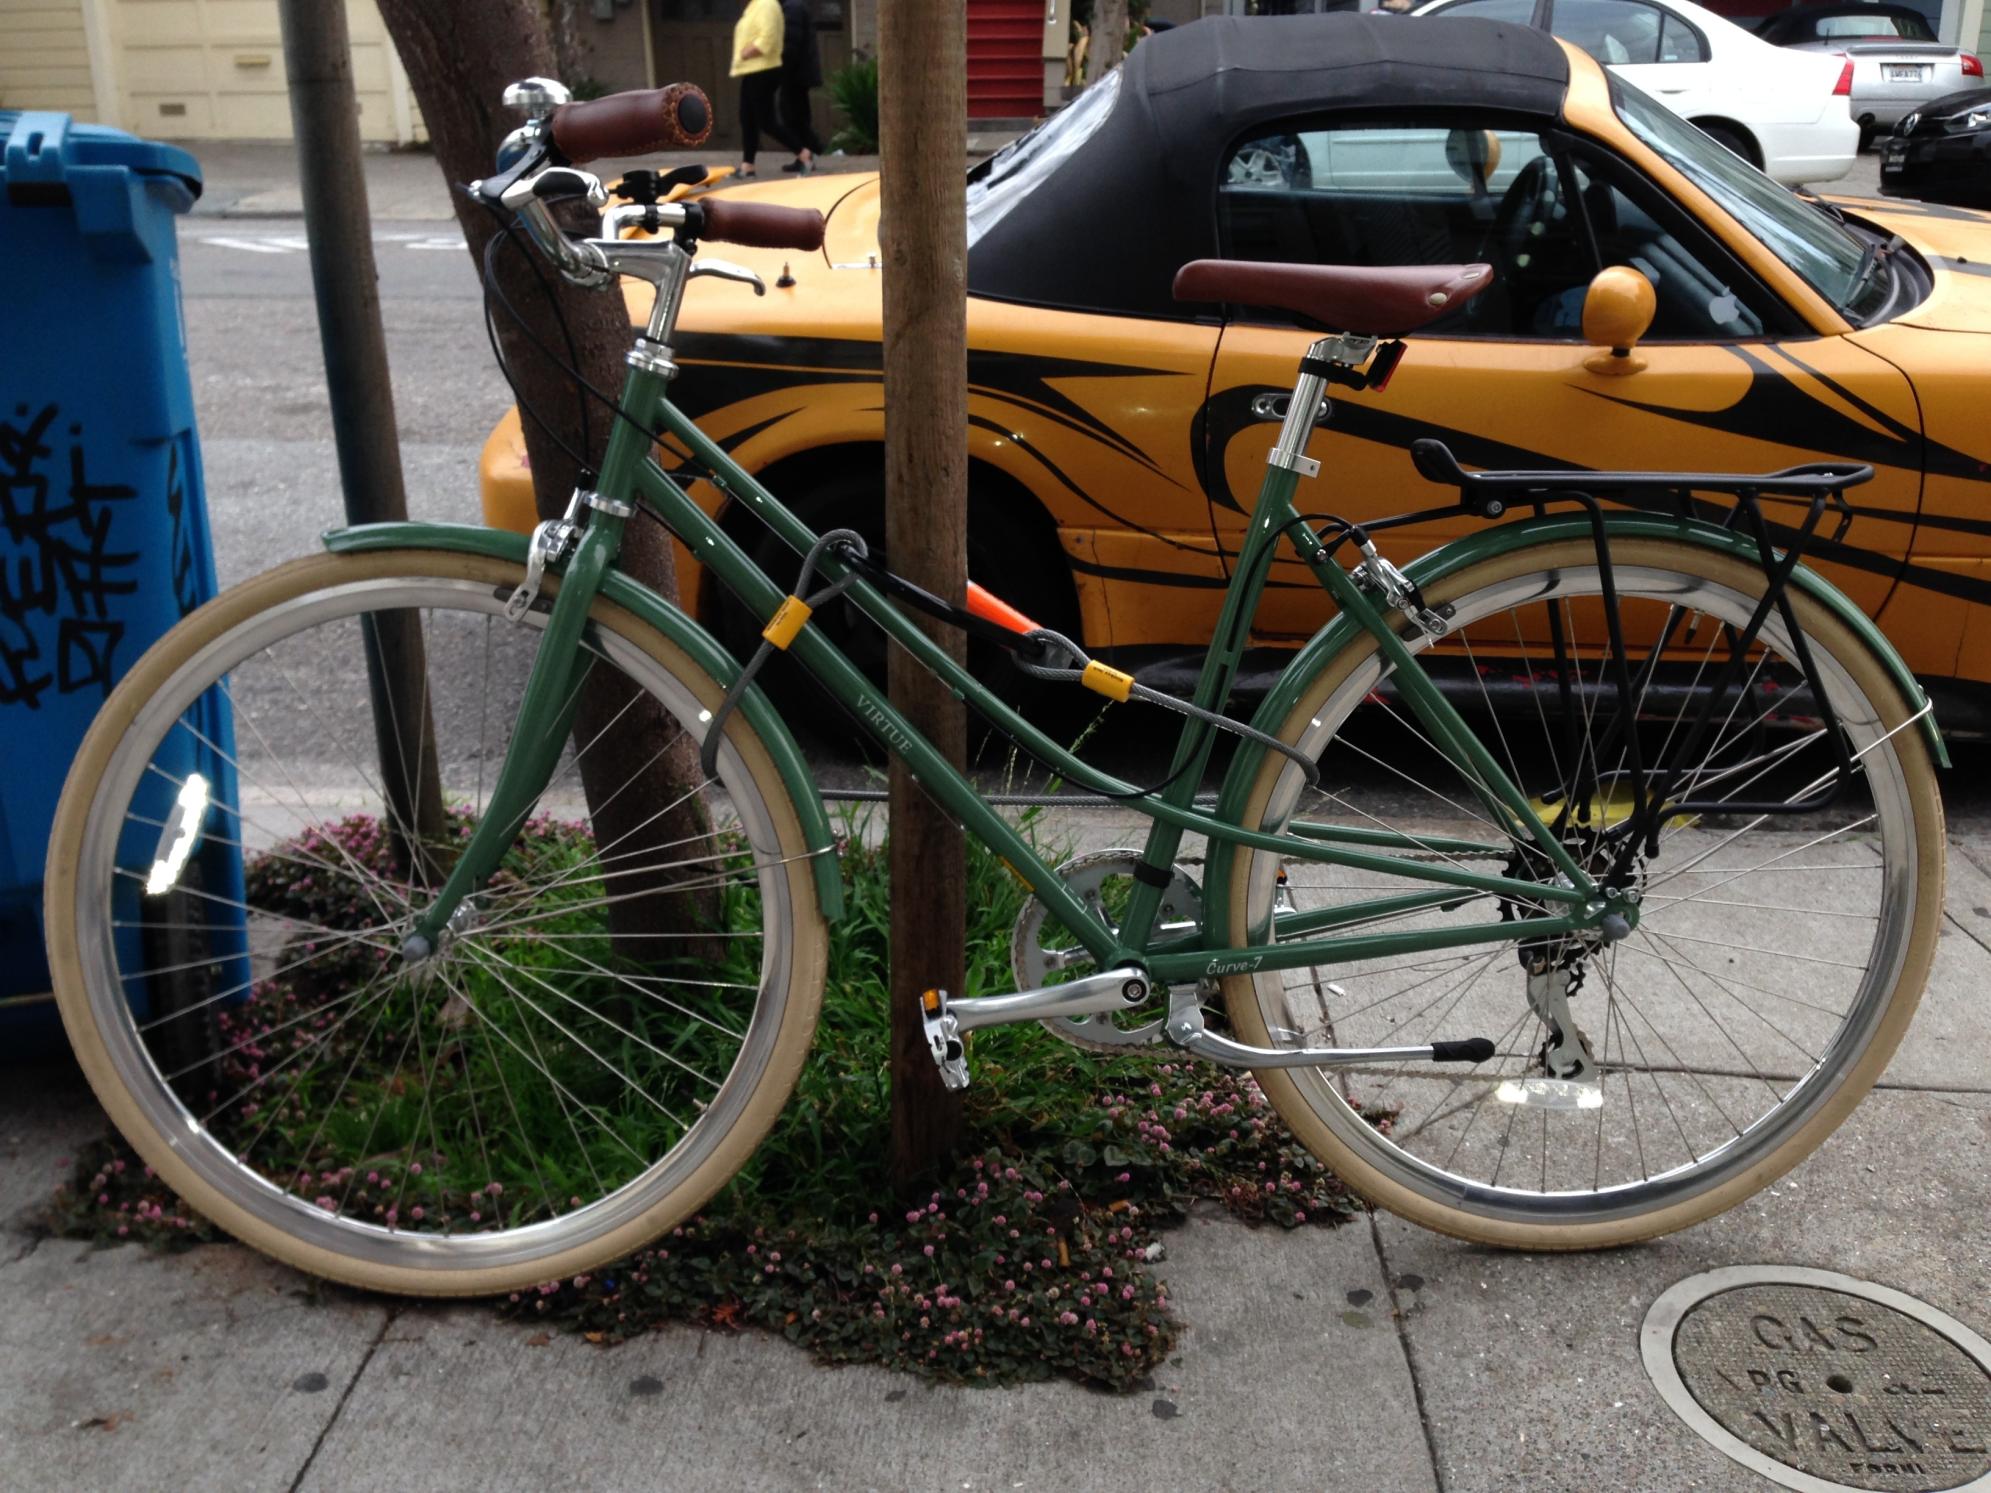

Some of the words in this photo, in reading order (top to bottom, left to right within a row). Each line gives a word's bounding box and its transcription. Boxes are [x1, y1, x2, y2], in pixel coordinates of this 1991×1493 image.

[857, 694, 913, 754] VIRTUE
[1206, 956, 1263, 975] Curve-7
[1751, 1315, 1878, 1352] GAS
[1754, 1411, 1988, 1454] VALVE
